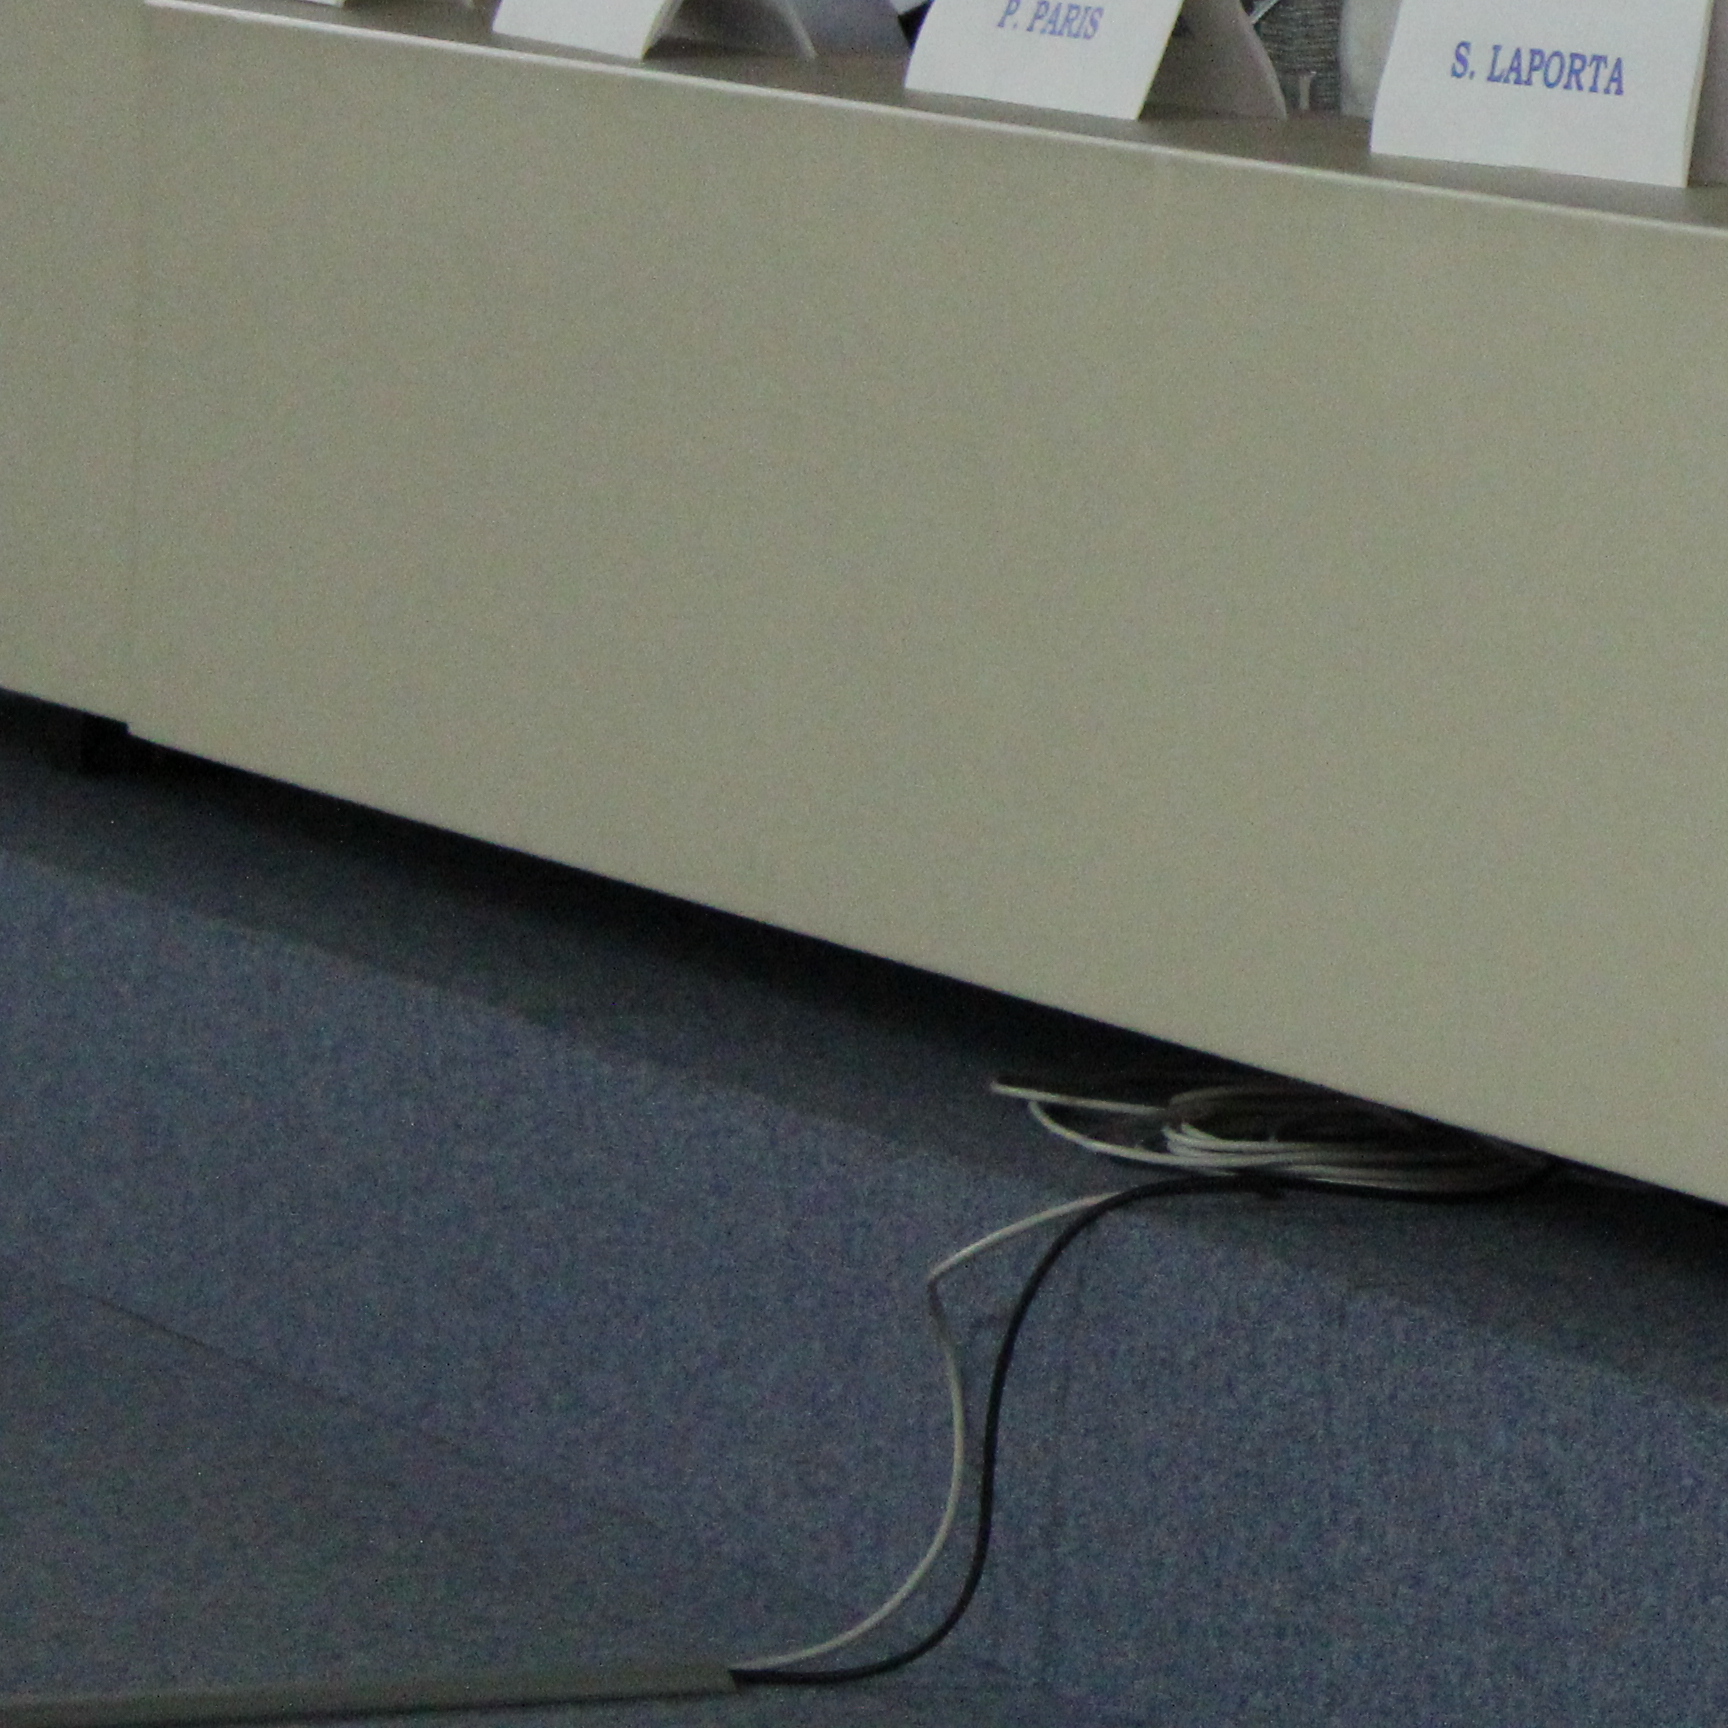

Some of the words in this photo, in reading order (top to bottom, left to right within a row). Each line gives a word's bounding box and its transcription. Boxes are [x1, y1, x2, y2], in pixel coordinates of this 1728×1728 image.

[1025, 0, 1104, 40] PARIS
[1451, 41, 1475, 80] S.
[1486, 44, 1624, 96] LAPORTA
